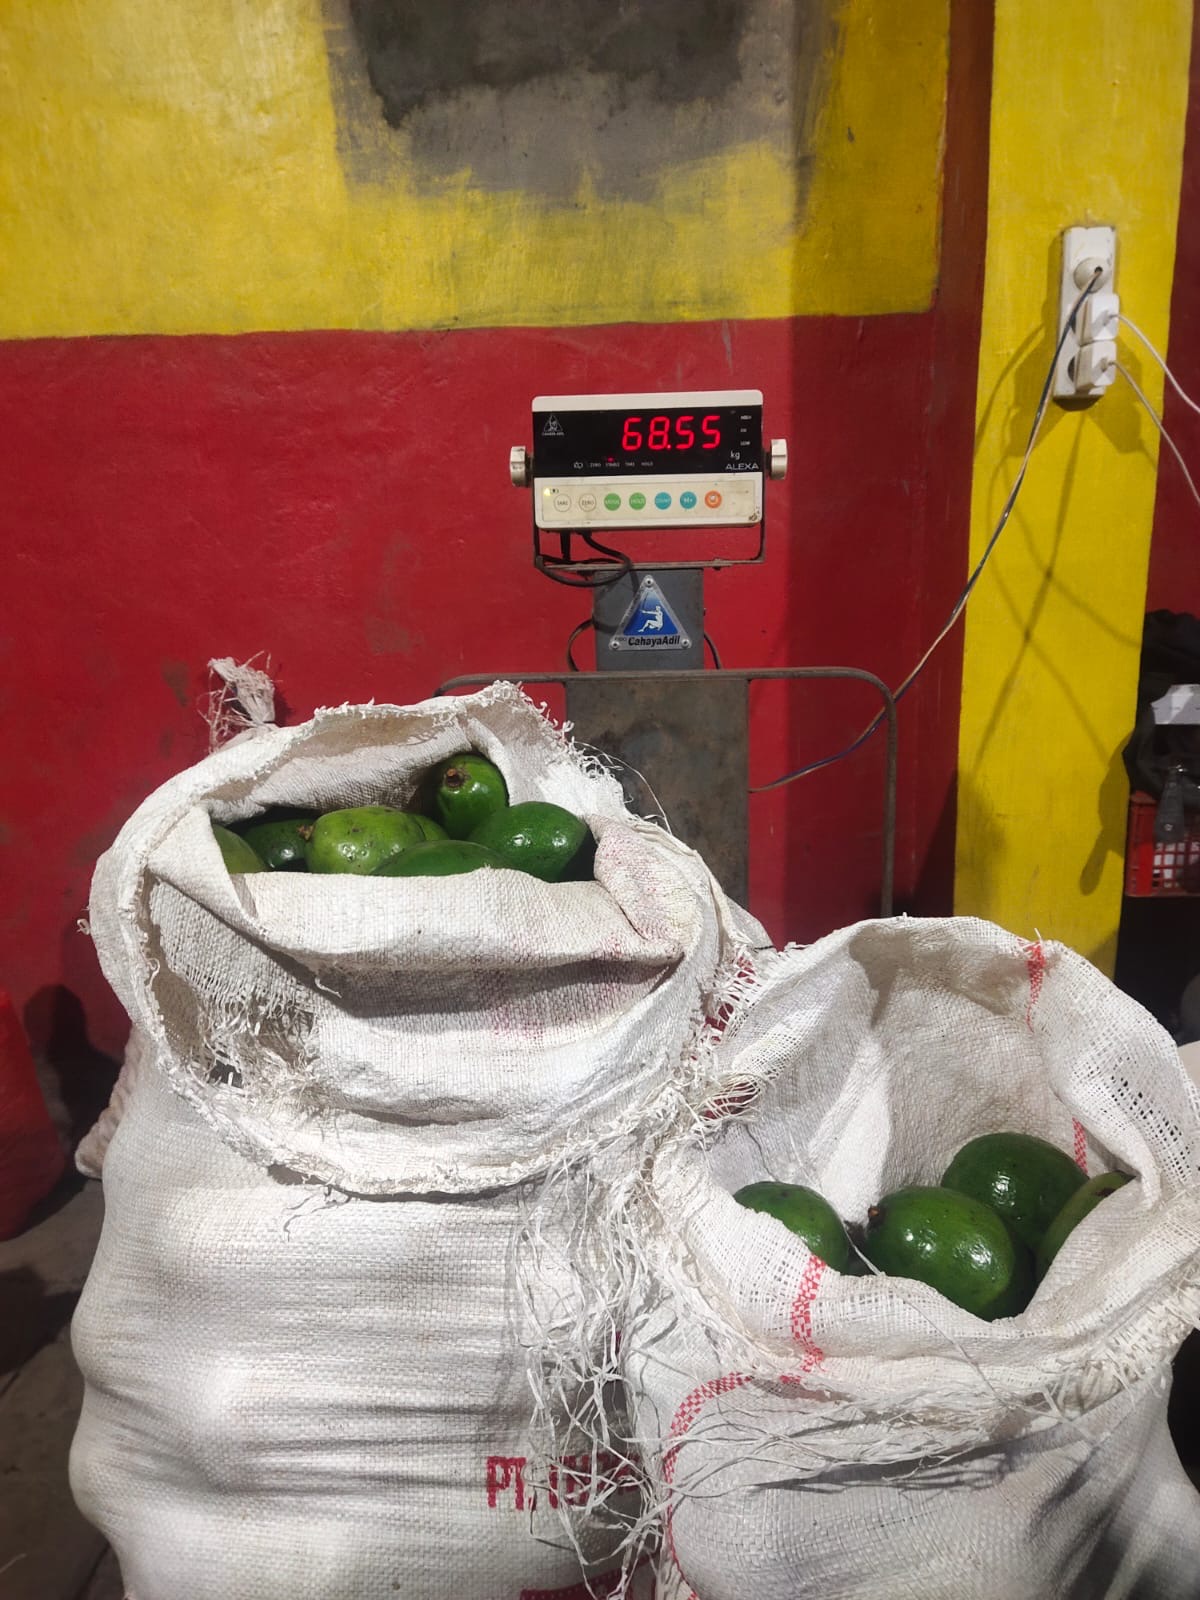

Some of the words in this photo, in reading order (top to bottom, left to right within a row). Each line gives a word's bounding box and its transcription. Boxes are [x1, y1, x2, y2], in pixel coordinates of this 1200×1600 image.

[622, 415, 721, 451] 68.55
[730, 450, 741, 460] kg
[725, 463, 760, 471] ALEXA
[628, 635, 681, 648] CahayaAdil
